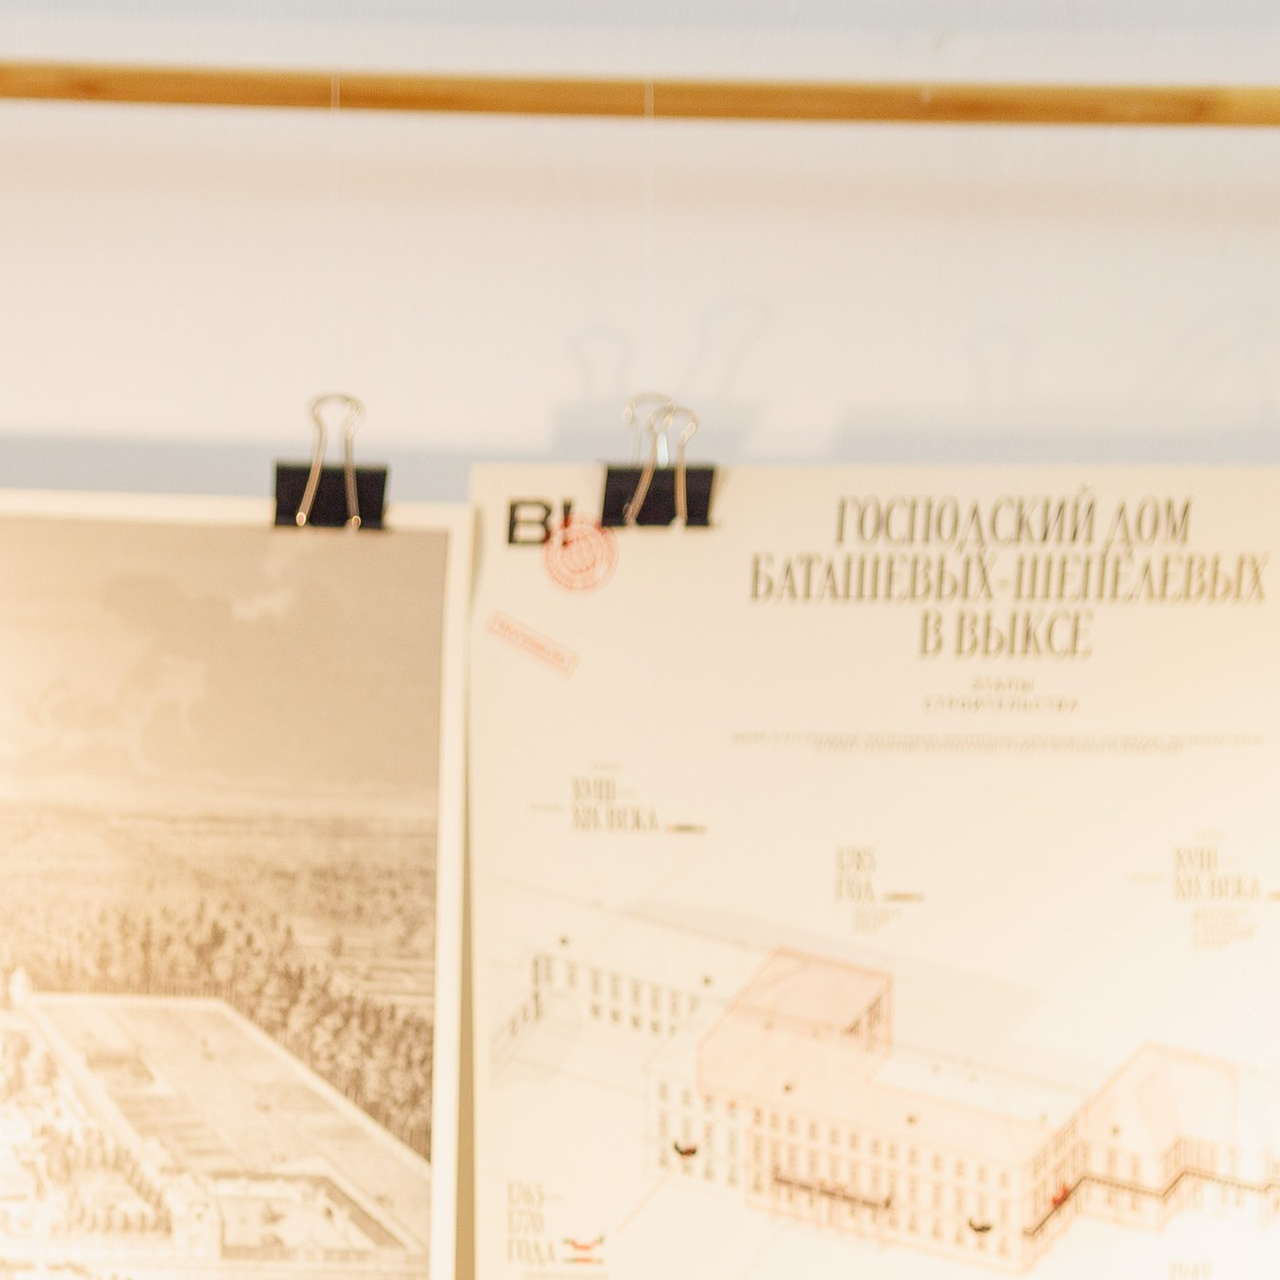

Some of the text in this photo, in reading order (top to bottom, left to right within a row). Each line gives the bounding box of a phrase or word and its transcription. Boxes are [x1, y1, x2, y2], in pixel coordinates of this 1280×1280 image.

[834, 486, 1193, 558] ГОСПОДСКИЙ ДОМ
[919, 608, 1094, 659] В ВЫКСЕ
